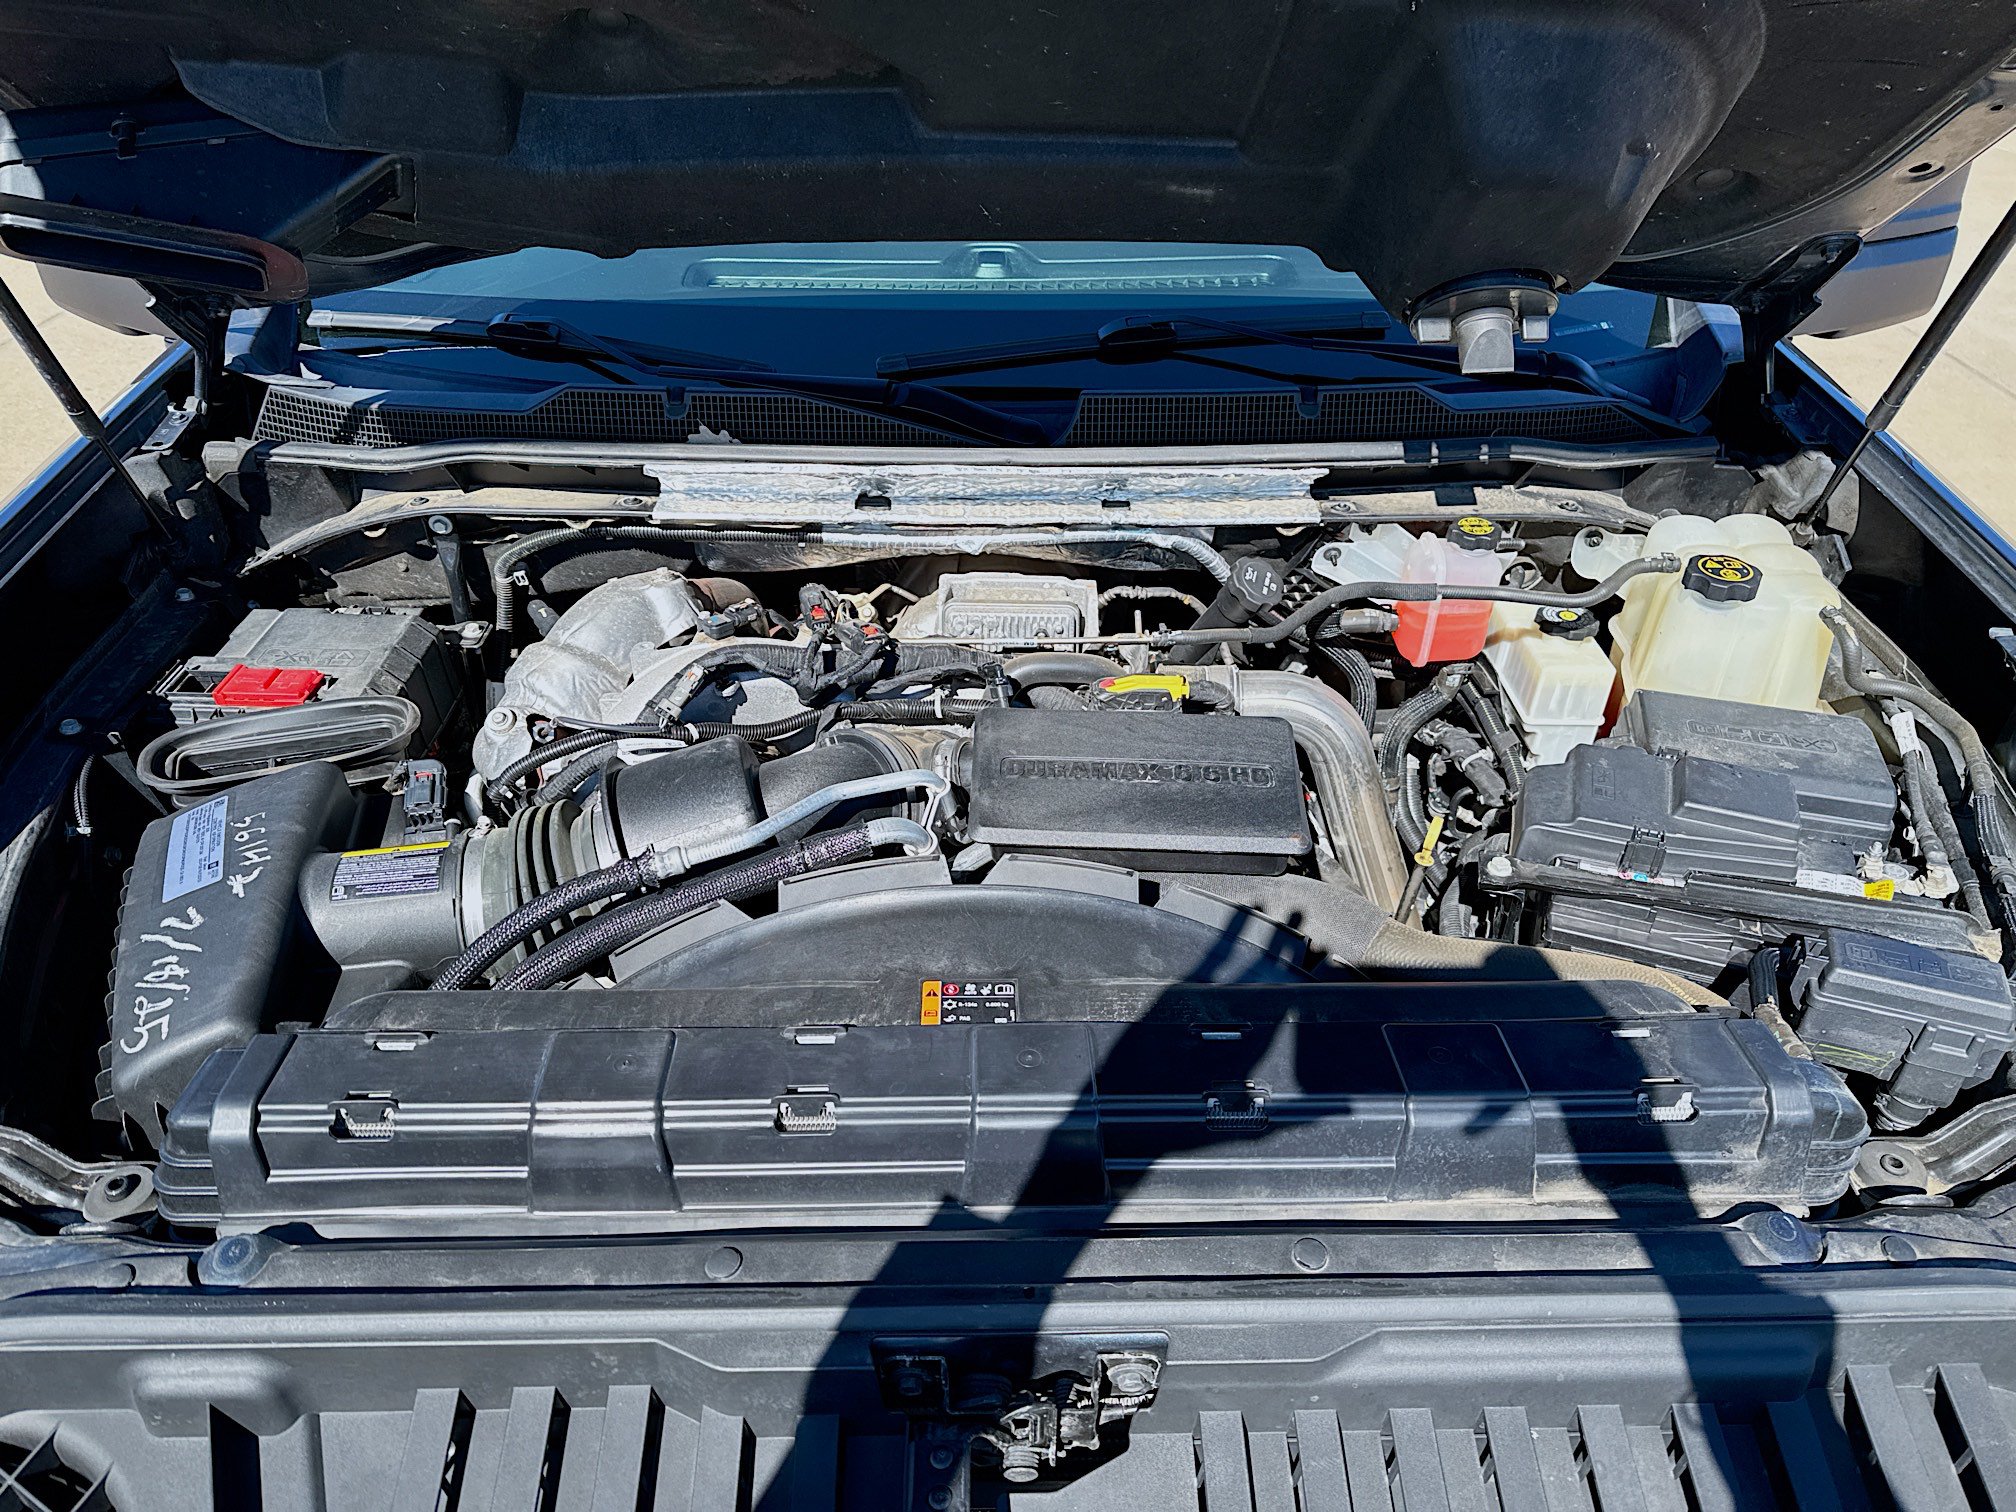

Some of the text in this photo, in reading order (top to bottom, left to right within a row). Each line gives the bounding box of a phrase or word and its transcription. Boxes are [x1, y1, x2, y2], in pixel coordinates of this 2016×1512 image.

[1005, 760, 1161, 783] DURAMAX
[1229, 765, 1273, 785] HD
[120, 906, 205, 1055] 7/18/25
